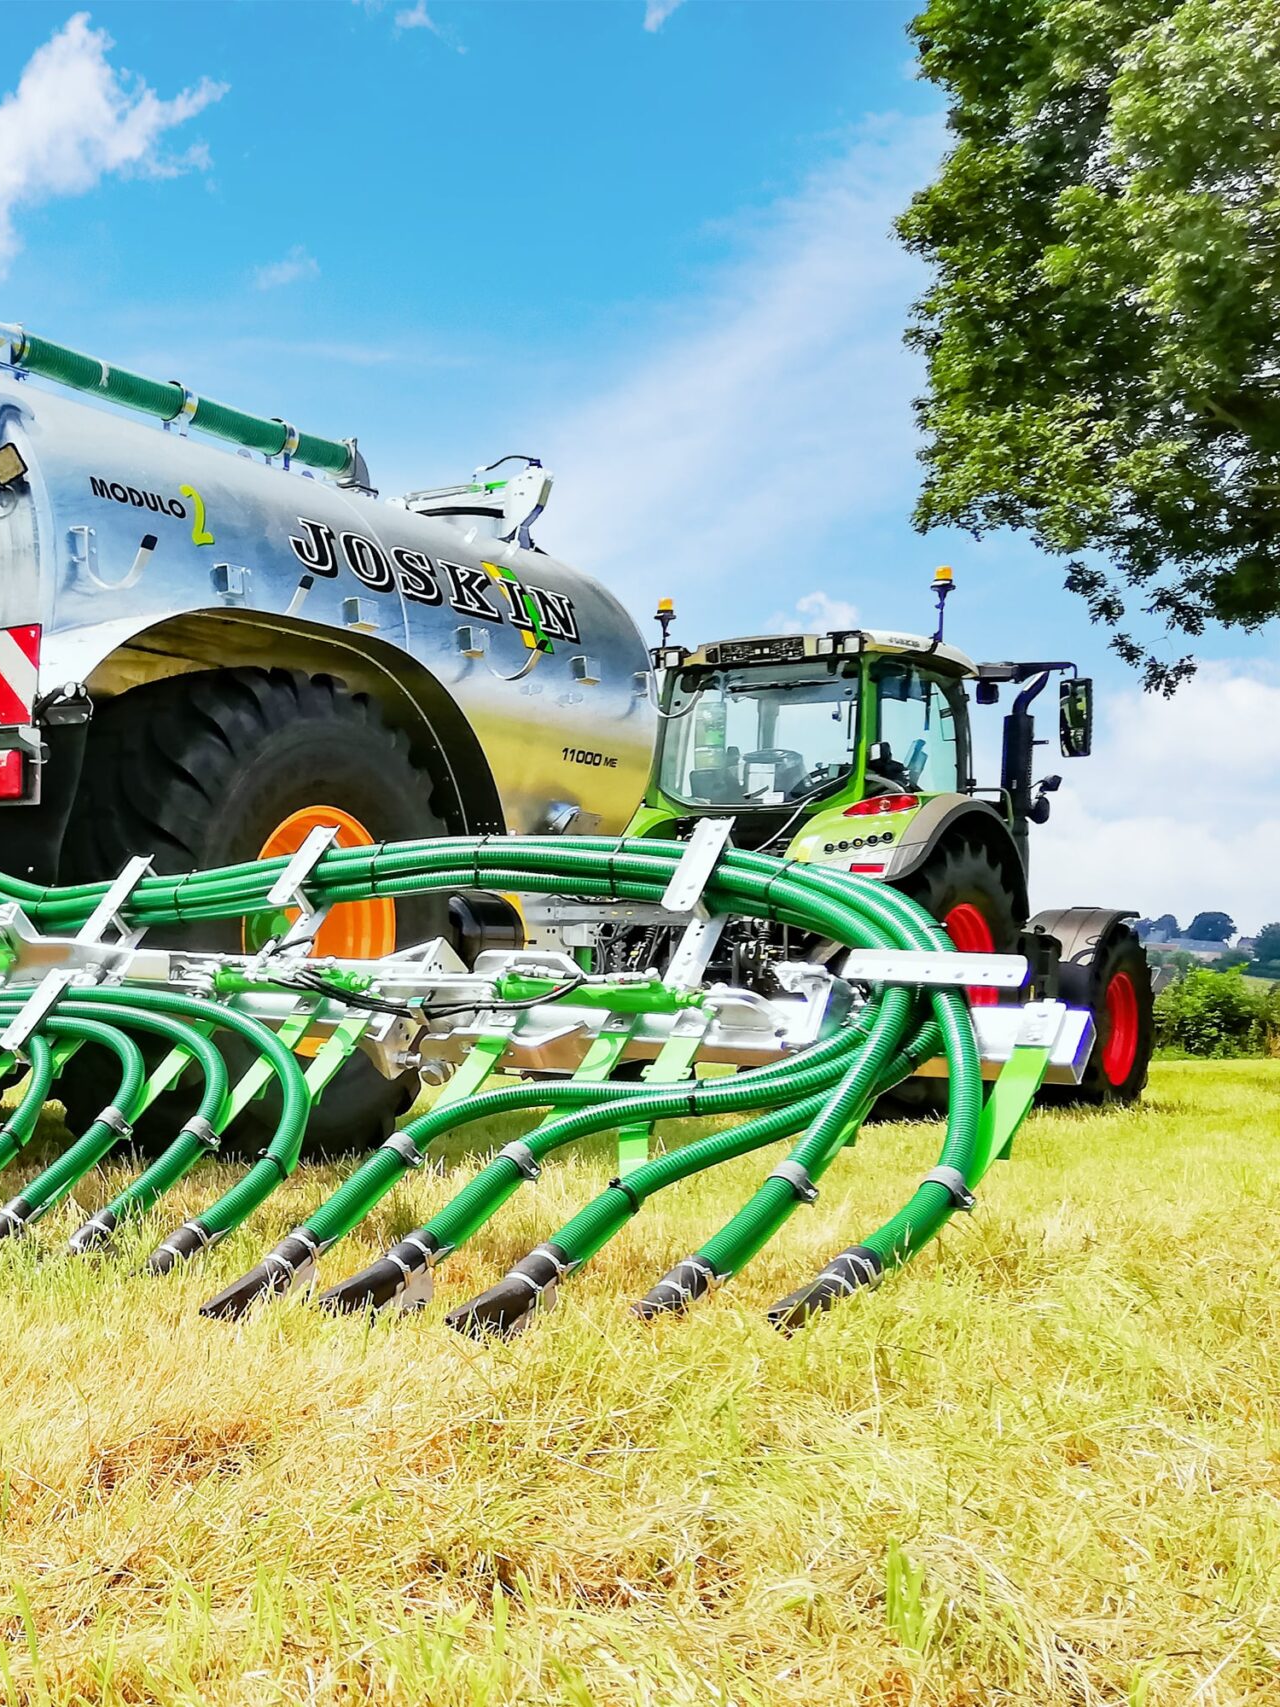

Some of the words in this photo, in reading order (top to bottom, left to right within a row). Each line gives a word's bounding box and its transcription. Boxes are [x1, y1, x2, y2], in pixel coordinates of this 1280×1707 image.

[89, 476, 187, 519] MODULO
[179, 484, 215, 547] 2
[289, 516, 581, 645] JOSKIN
[562, 747, 603, 767] 11000
